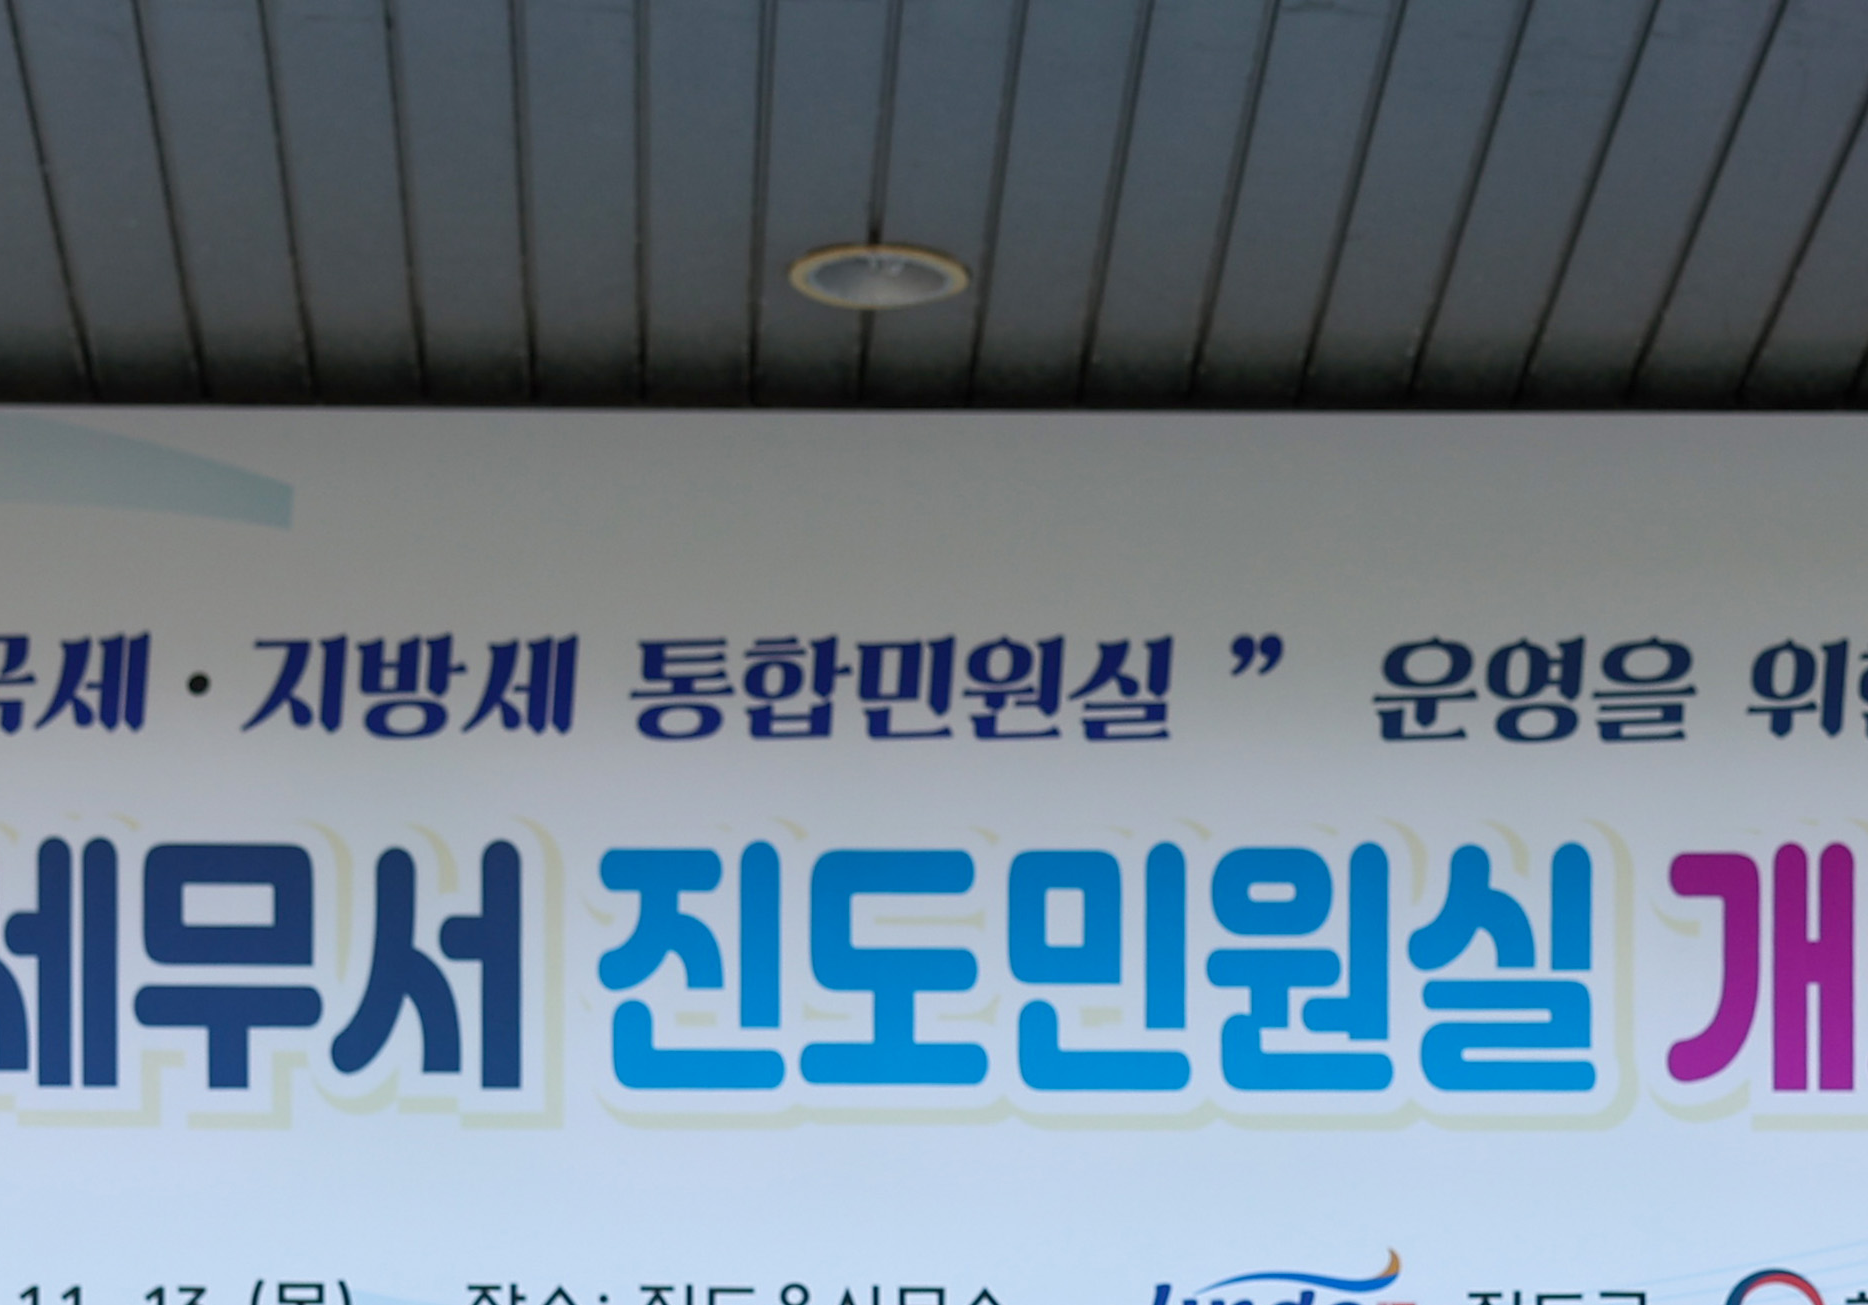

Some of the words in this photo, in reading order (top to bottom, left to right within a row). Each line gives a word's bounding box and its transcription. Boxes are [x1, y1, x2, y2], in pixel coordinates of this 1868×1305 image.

[630, 634, 1174, 741] 통합민원실
[1373, 635, 1697, 743] 운영을
[597, 840, 1597, 1092] 진도민원실
